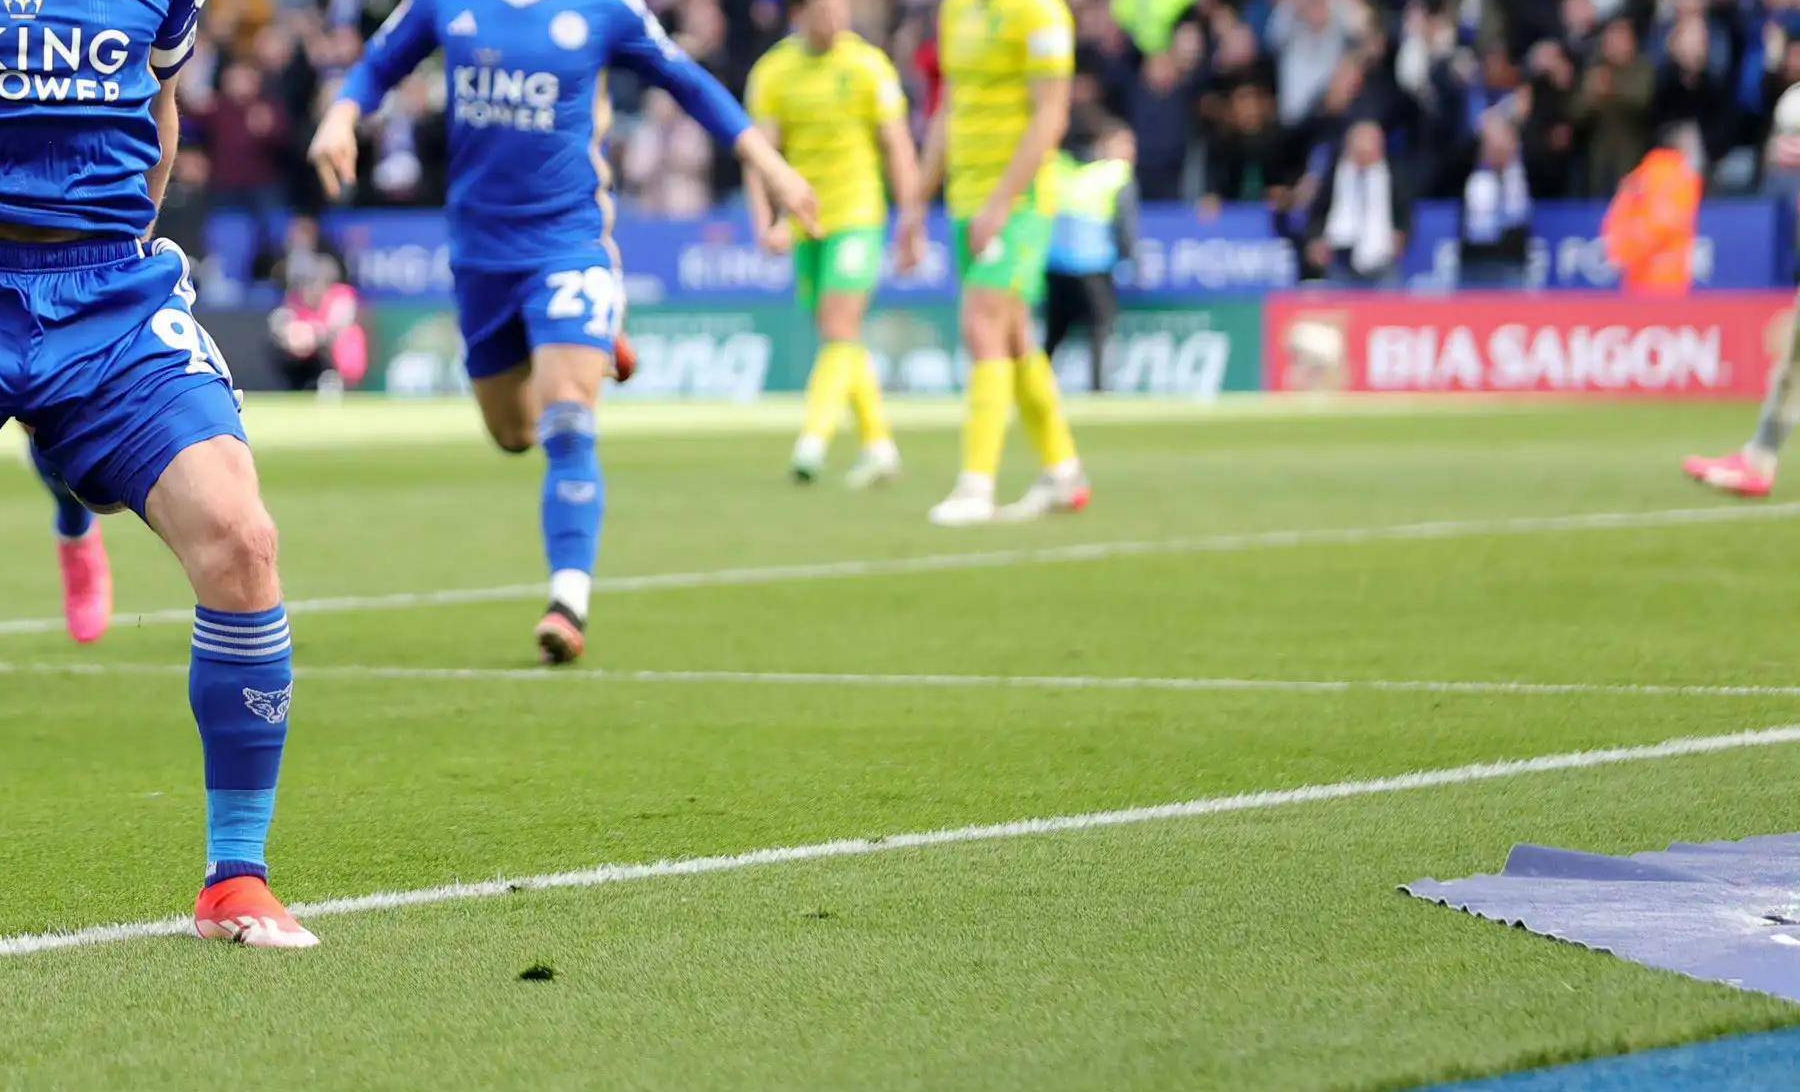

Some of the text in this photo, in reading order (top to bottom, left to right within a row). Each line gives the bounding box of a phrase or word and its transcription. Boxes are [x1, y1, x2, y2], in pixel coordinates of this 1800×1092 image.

[454, 65, 560, 109] KING
[545, 265, 613, 340] 29
[151, 308, 219, 375] 9
